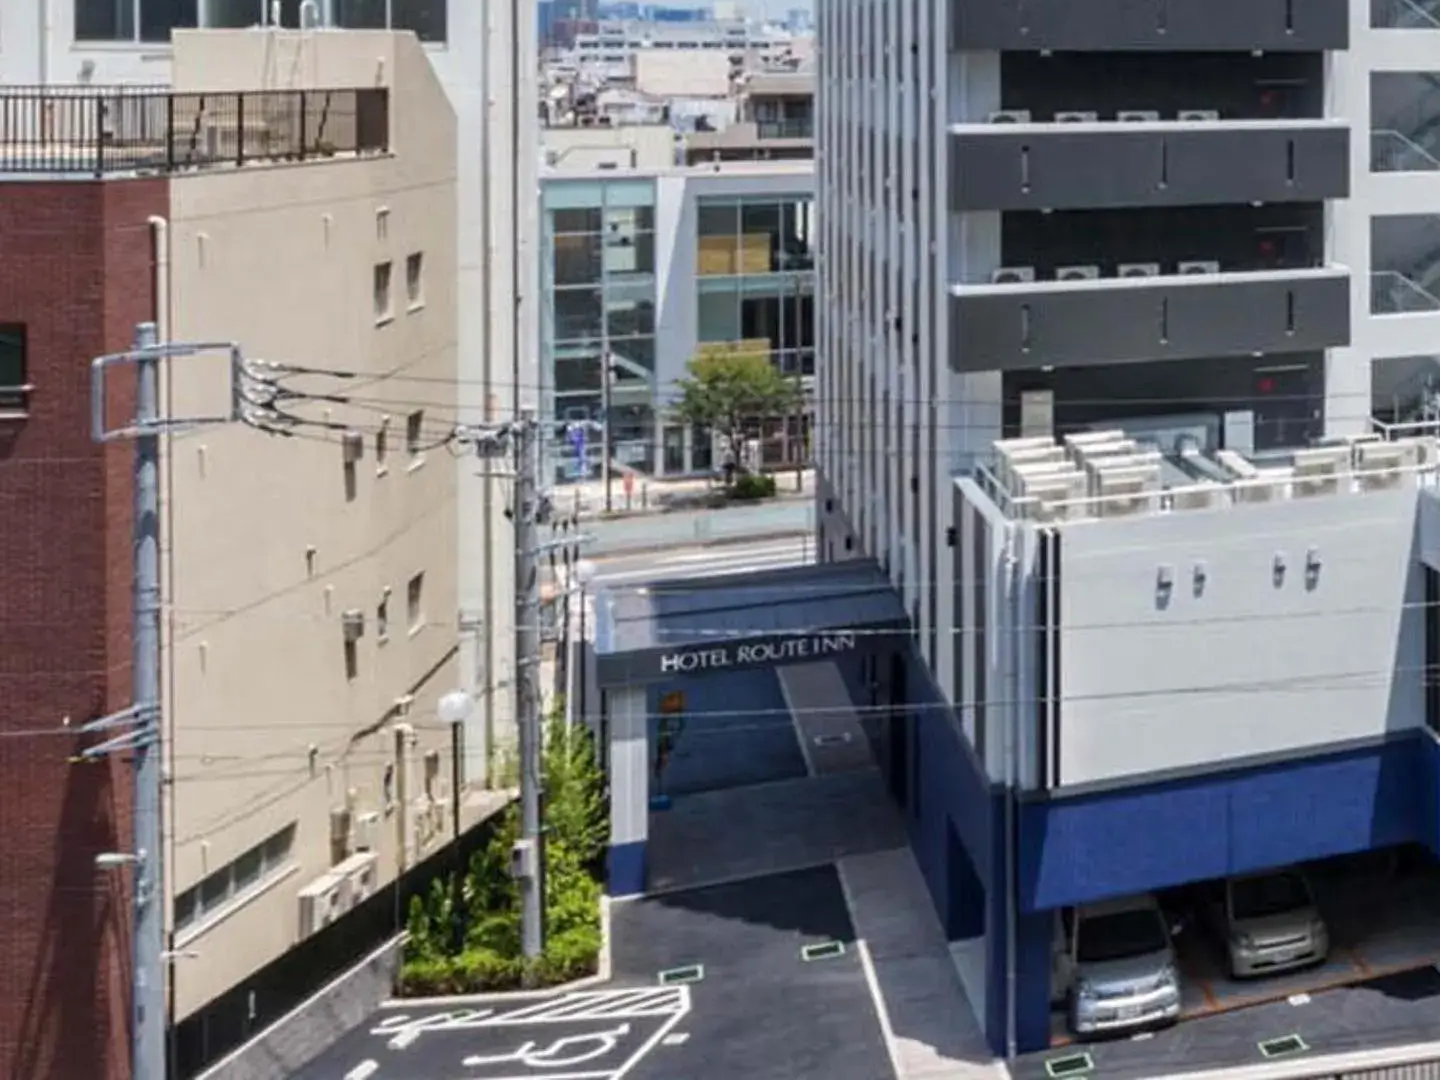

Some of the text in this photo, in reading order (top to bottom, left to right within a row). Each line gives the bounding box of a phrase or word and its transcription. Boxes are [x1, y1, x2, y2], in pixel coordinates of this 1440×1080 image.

[660, 634, 855, 672] HOTEL ROUTE INN
